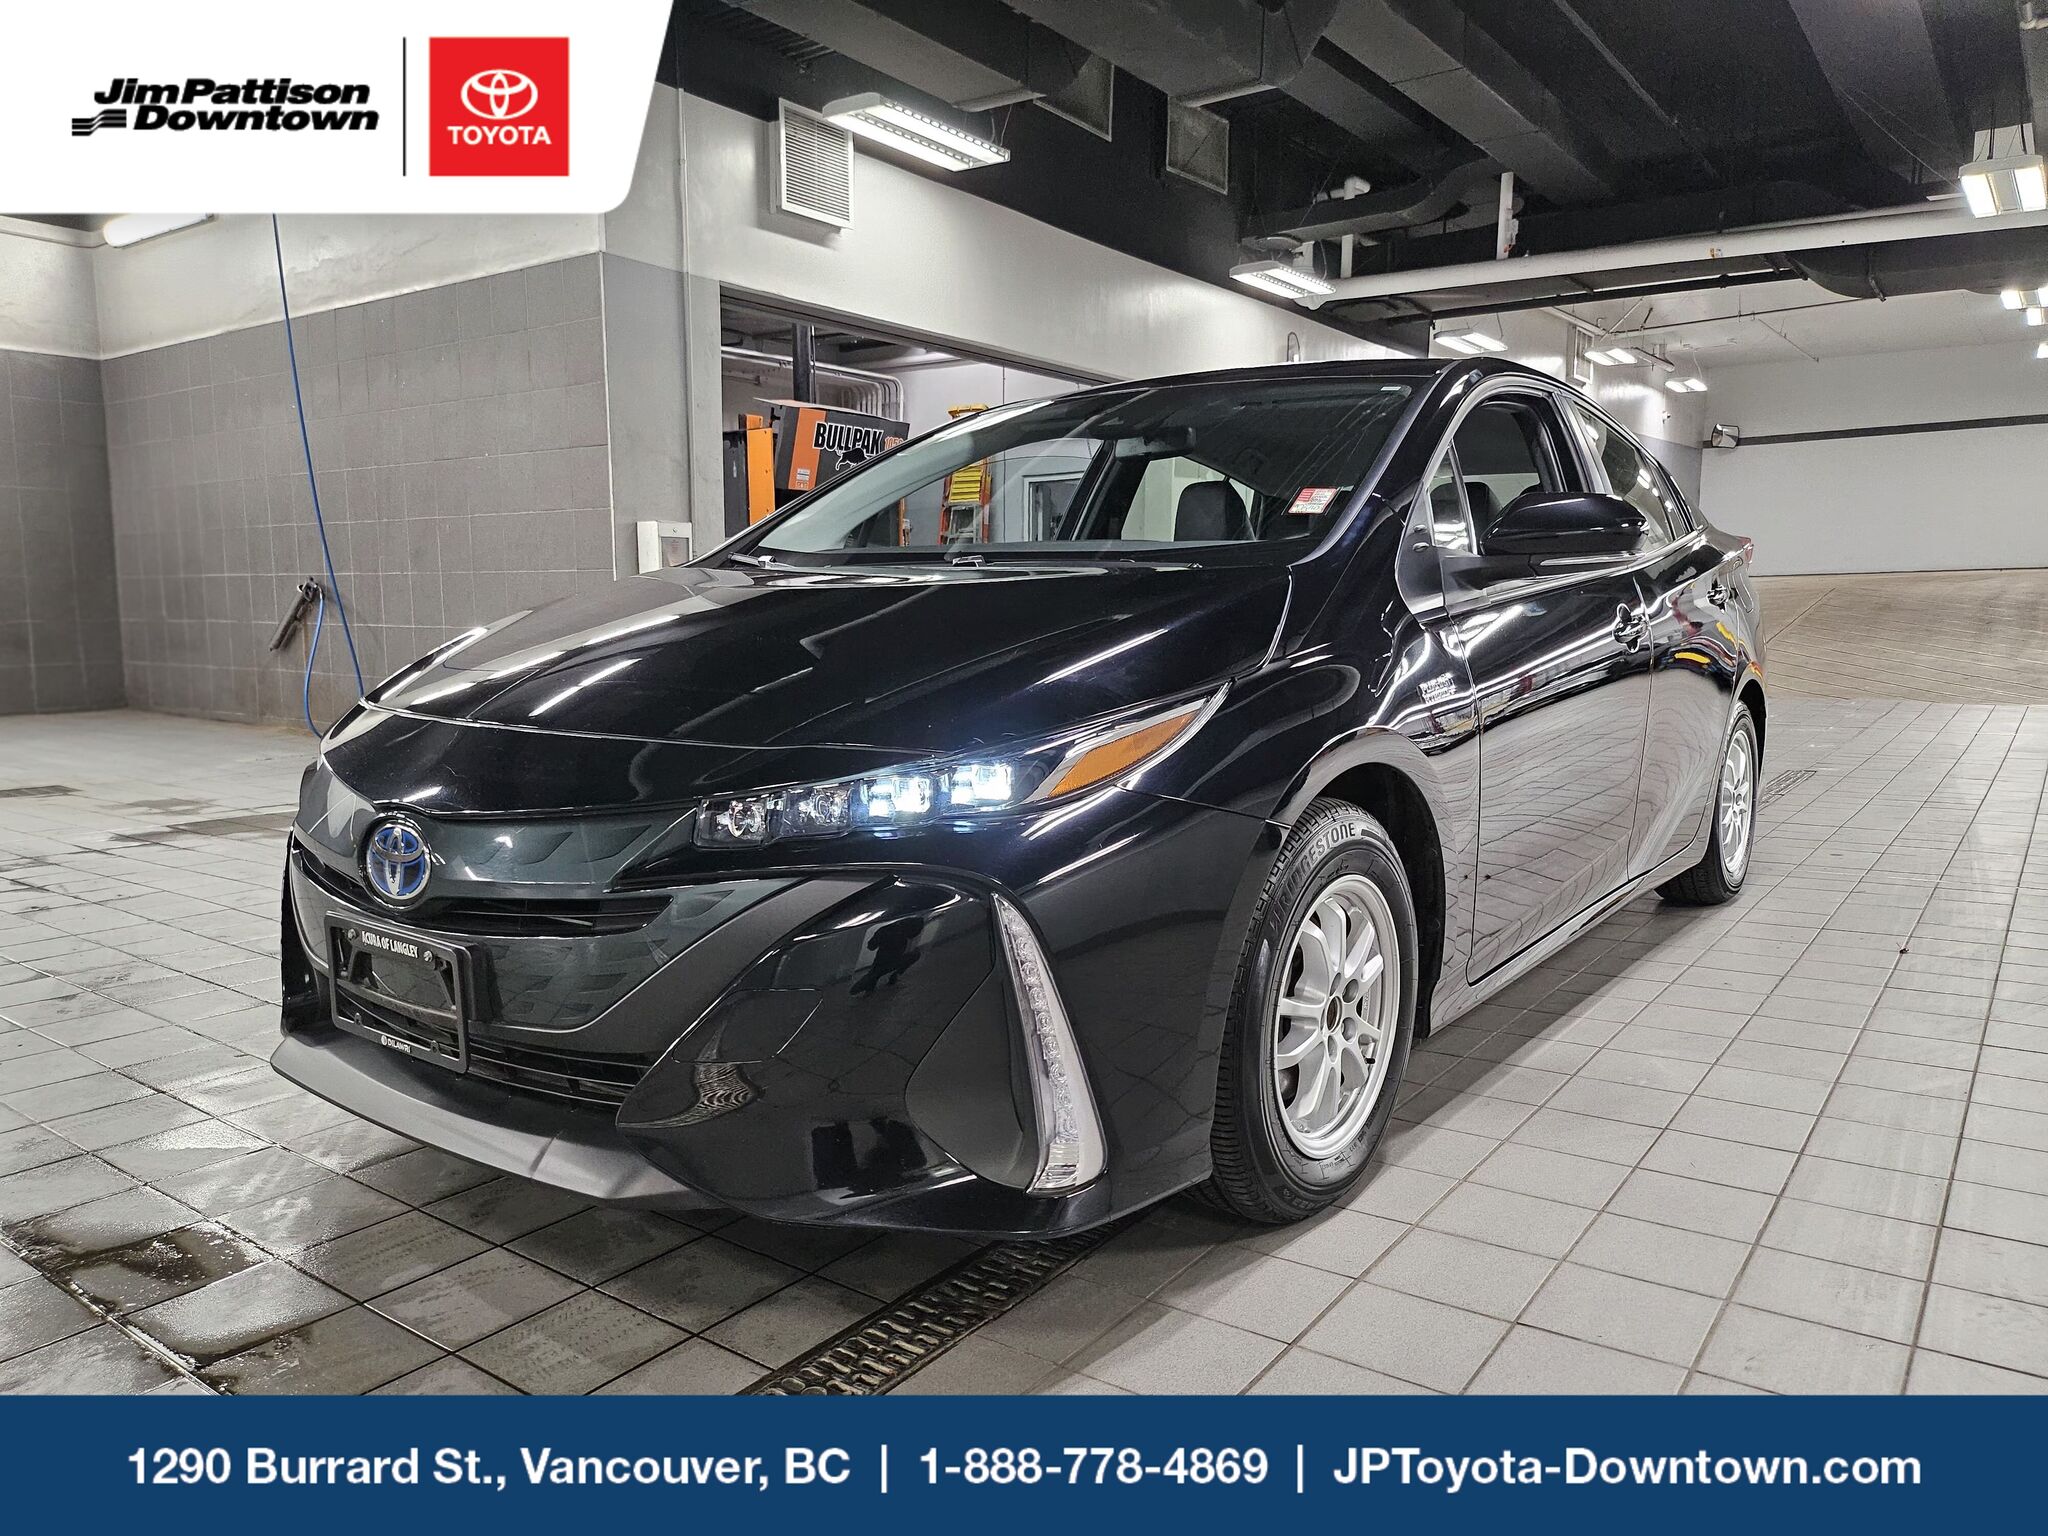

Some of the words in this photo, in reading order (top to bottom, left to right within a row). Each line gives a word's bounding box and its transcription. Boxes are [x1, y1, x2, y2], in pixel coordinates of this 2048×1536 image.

[812, 421, 884, 456] BULLPAK
[361, 930, 382, 948] ACURA
[380, 936, 390, 950] OF
[389, 939, 419, 959] LANGLEY
